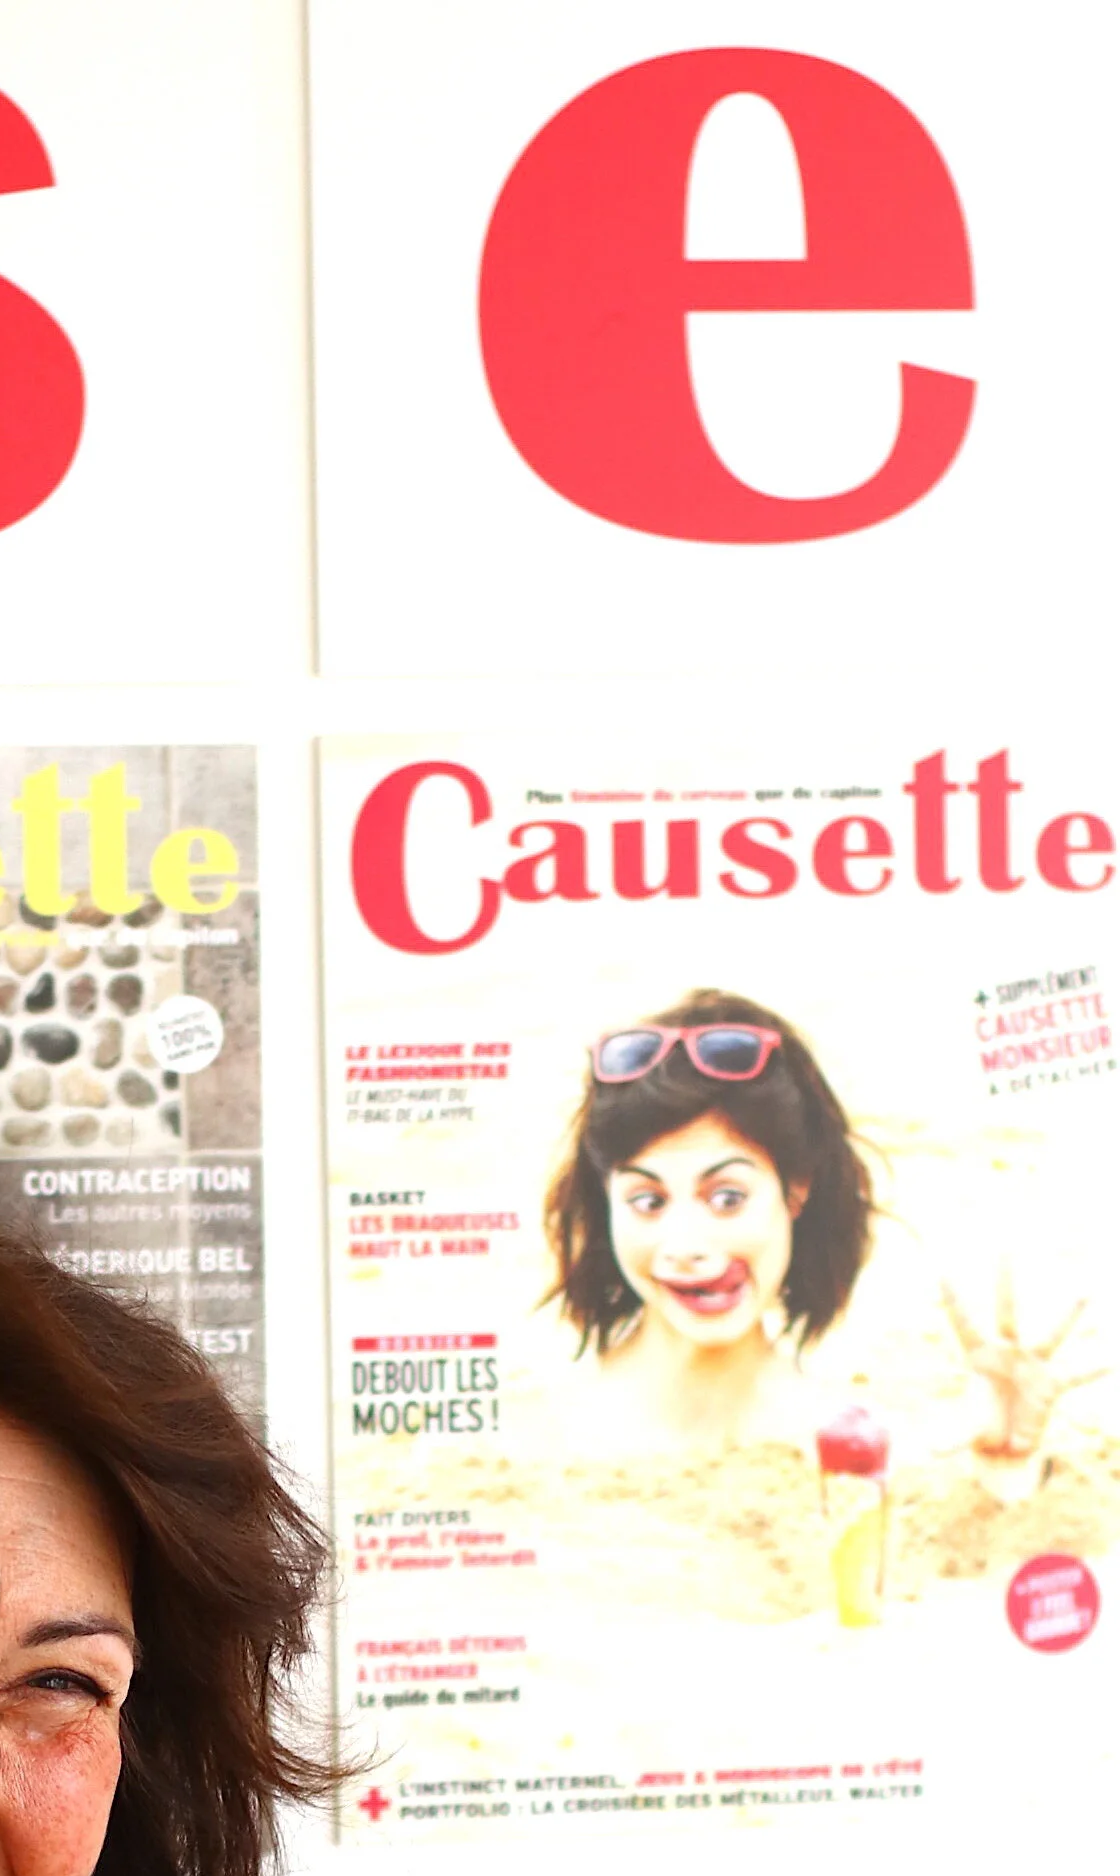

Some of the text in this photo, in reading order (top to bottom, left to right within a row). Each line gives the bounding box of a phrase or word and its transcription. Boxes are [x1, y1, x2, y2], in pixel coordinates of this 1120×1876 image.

[350, 748, 1116, 957] Causette
[976, 992, 1110, 1043] CAUSETTE
[979, 1024, 1112, 1074] MONSIEUR
[23, 1166, 251, 1196] CONTRACEPTION
[349, 1190, 426, 1207] BASKET
[49, 1203, 252, 1224] Les autres moyens
[349, 1215, 384, 1235] LES
[197, 1247, 253, 1272] BEL
[349, 1237, 490, 1259] HAUT LA MAIN
[351, 1356, 499, 1396] DEBOUT LES
[352, 1397, 484, 1435] MOCHES
[354, 1510, 472, 1527] FAIT DIVERS
[356, 1638, 442, 1659] FRANÇAIS
[357, 1690, 376, 1709] Le
[383, 1688, 429, 1711] guide
[436, 1687, 456, 1705] du
[399, 1778, 507, 1798] L'INSTINCT
[399, 1801, 513, 1820] PORTFOLIO
[530, 1801, 556, 1815] LA
[675, 1793, 711, 1809] DES
[849, 1784, 923, 1800] WALTER
